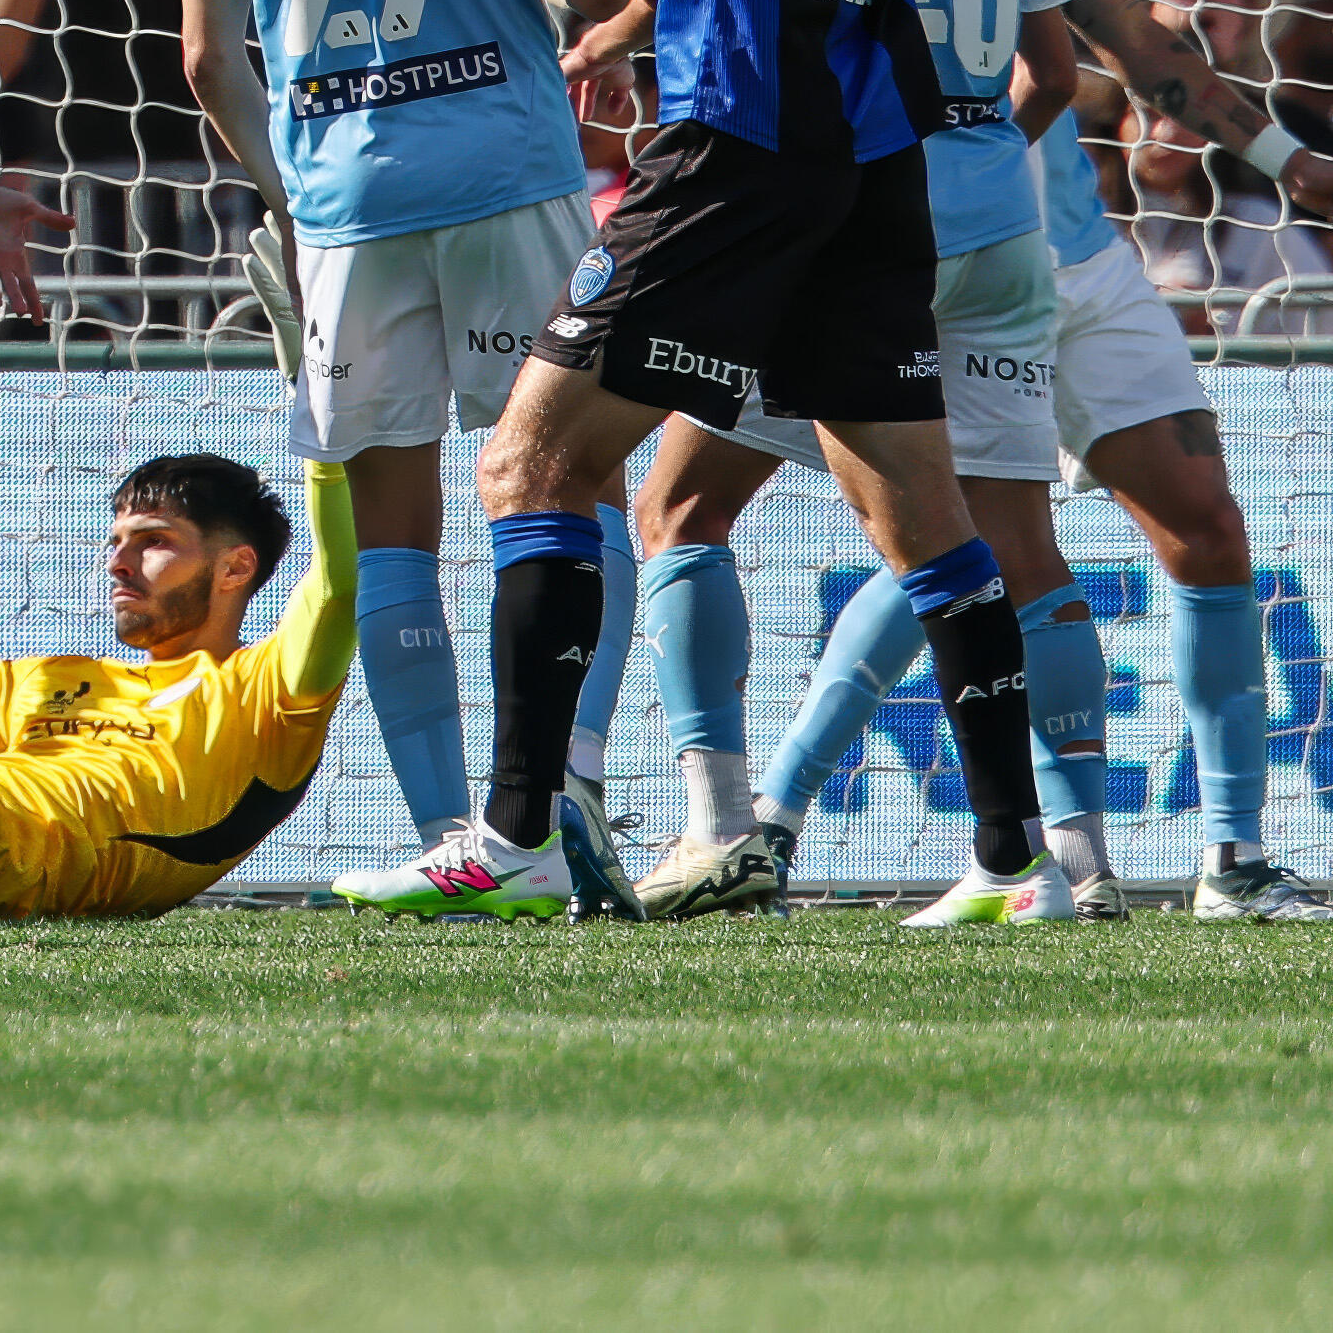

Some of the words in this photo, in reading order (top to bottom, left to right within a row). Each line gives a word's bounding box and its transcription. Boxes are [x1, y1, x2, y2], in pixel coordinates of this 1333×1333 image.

[348, 51, 501, 105] HOSTPLUS
[468, 329, 534, 358] NOS
[644, 337, 758, 398] Ebury
[398, 627, 445, 649] CITY
[1044, 709, 1092, 735] CITY
